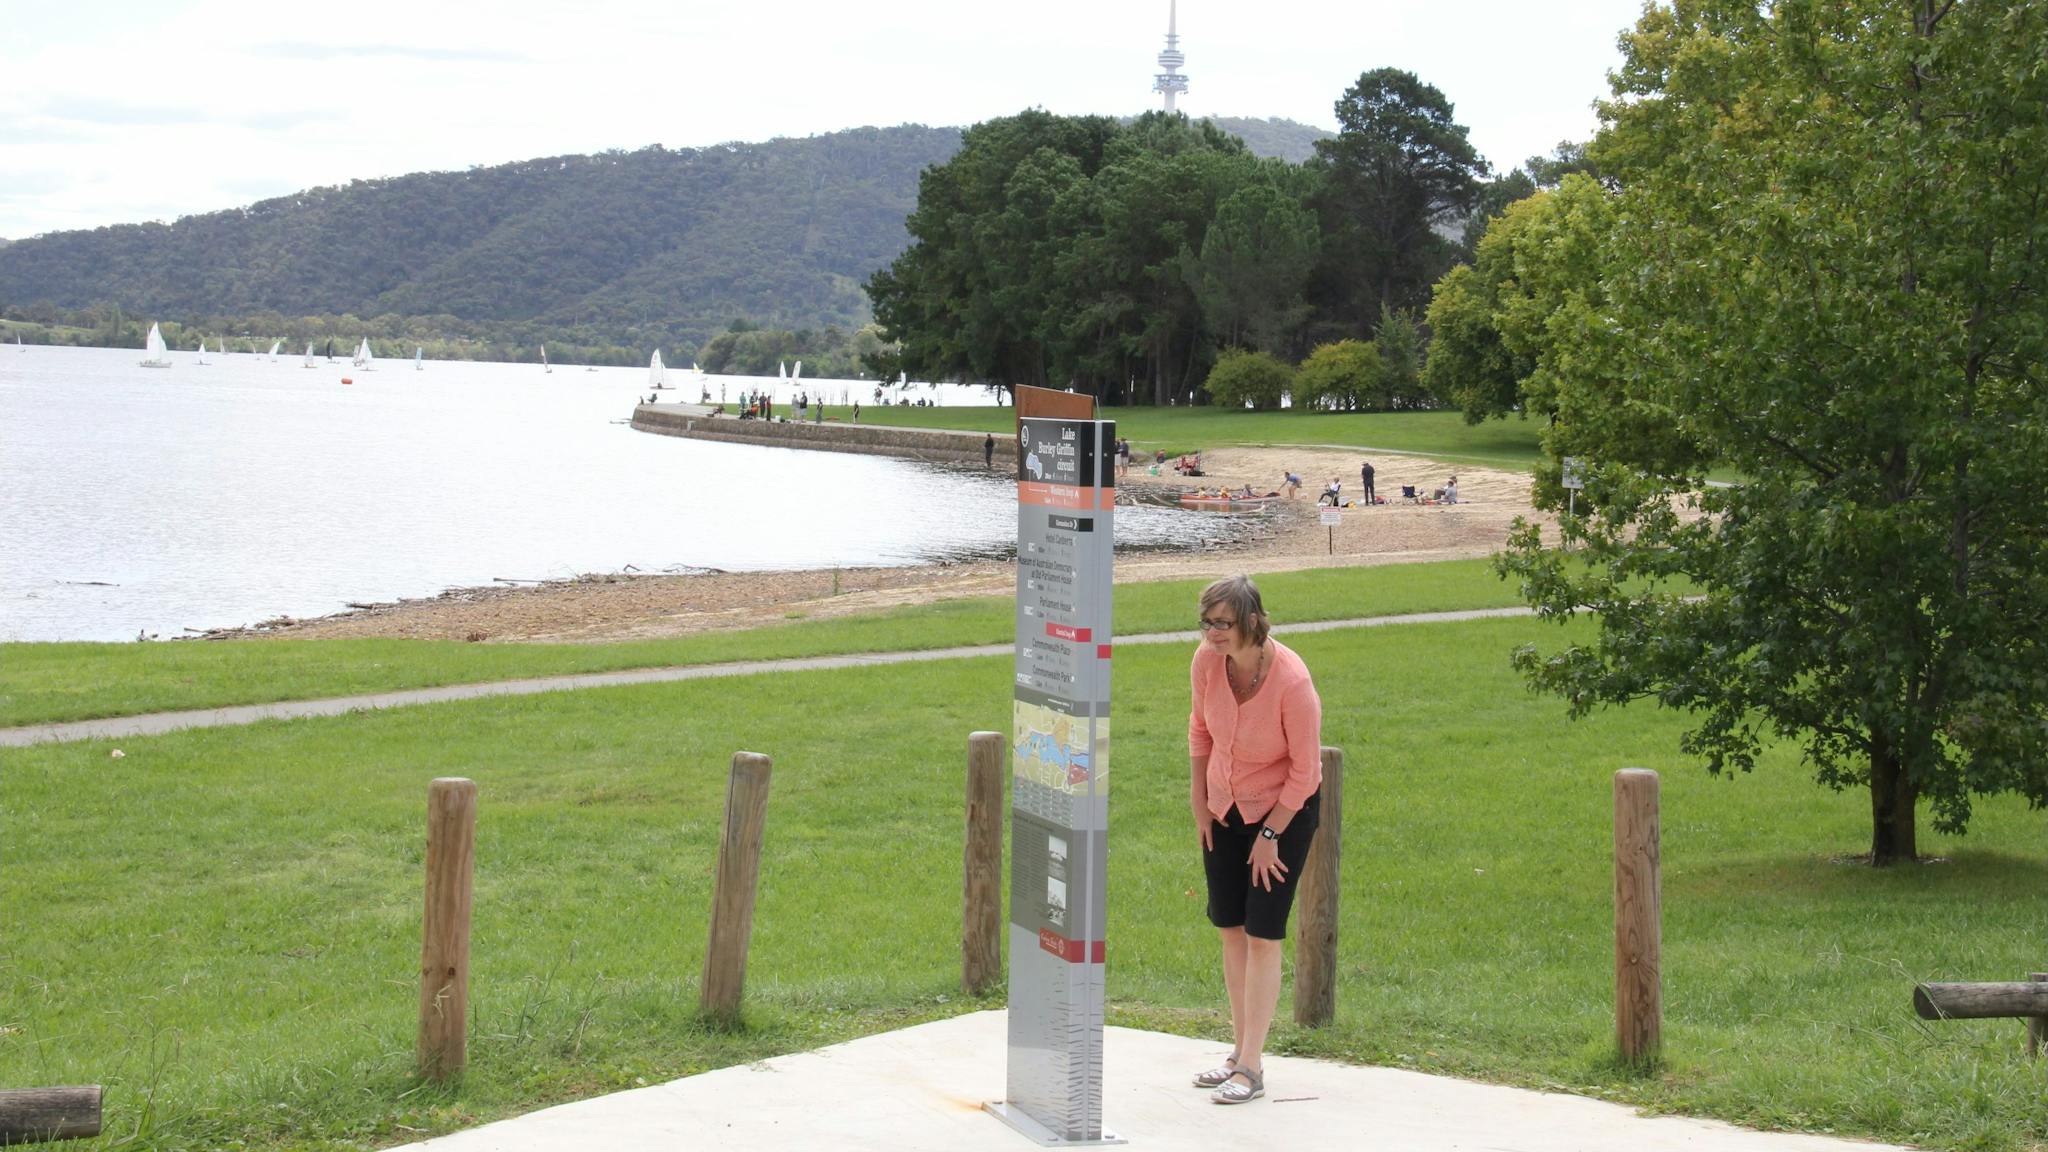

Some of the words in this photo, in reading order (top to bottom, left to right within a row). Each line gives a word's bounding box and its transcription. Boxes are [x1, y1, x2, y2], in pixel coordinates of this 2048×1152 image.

[1061, 427, 1075, 440] Lake
[1038, 441, 1056, 457] Burley
[1056, 442, 1075, 456] Griffin
[1057, 459, 1075, 472] circuit
